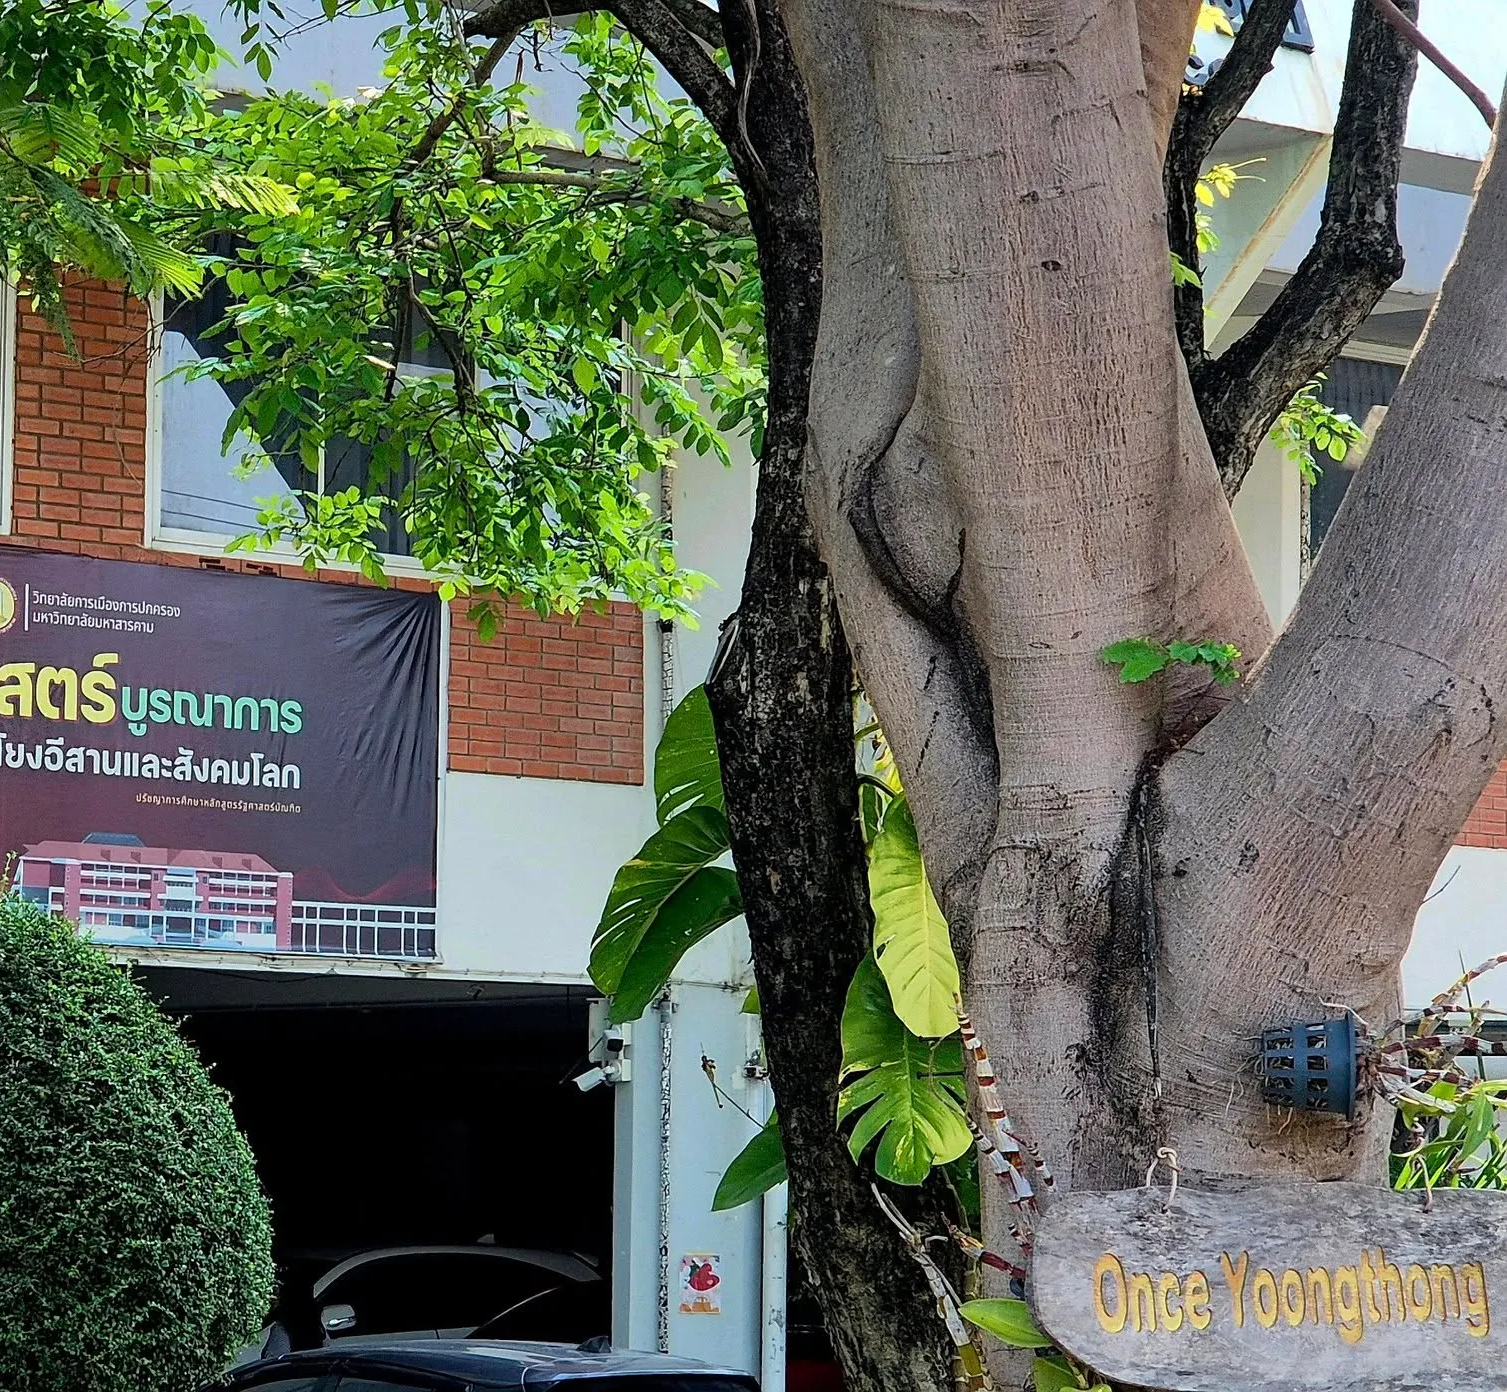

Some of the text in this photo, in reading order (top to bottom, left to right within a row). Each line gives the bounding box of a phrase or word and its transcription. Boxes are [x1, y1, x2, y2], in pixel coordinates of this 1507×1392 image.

[32, 590, 181, 618] วิทยาลัยการเมืองการปกครอง
[32, 611, 154, 634] มหาวิทยาลัยมหาสารคาม
[121, 685, 304, 737] บูรณาการ
[1093, 1245, 1491, 1344] Once Yoongthong
